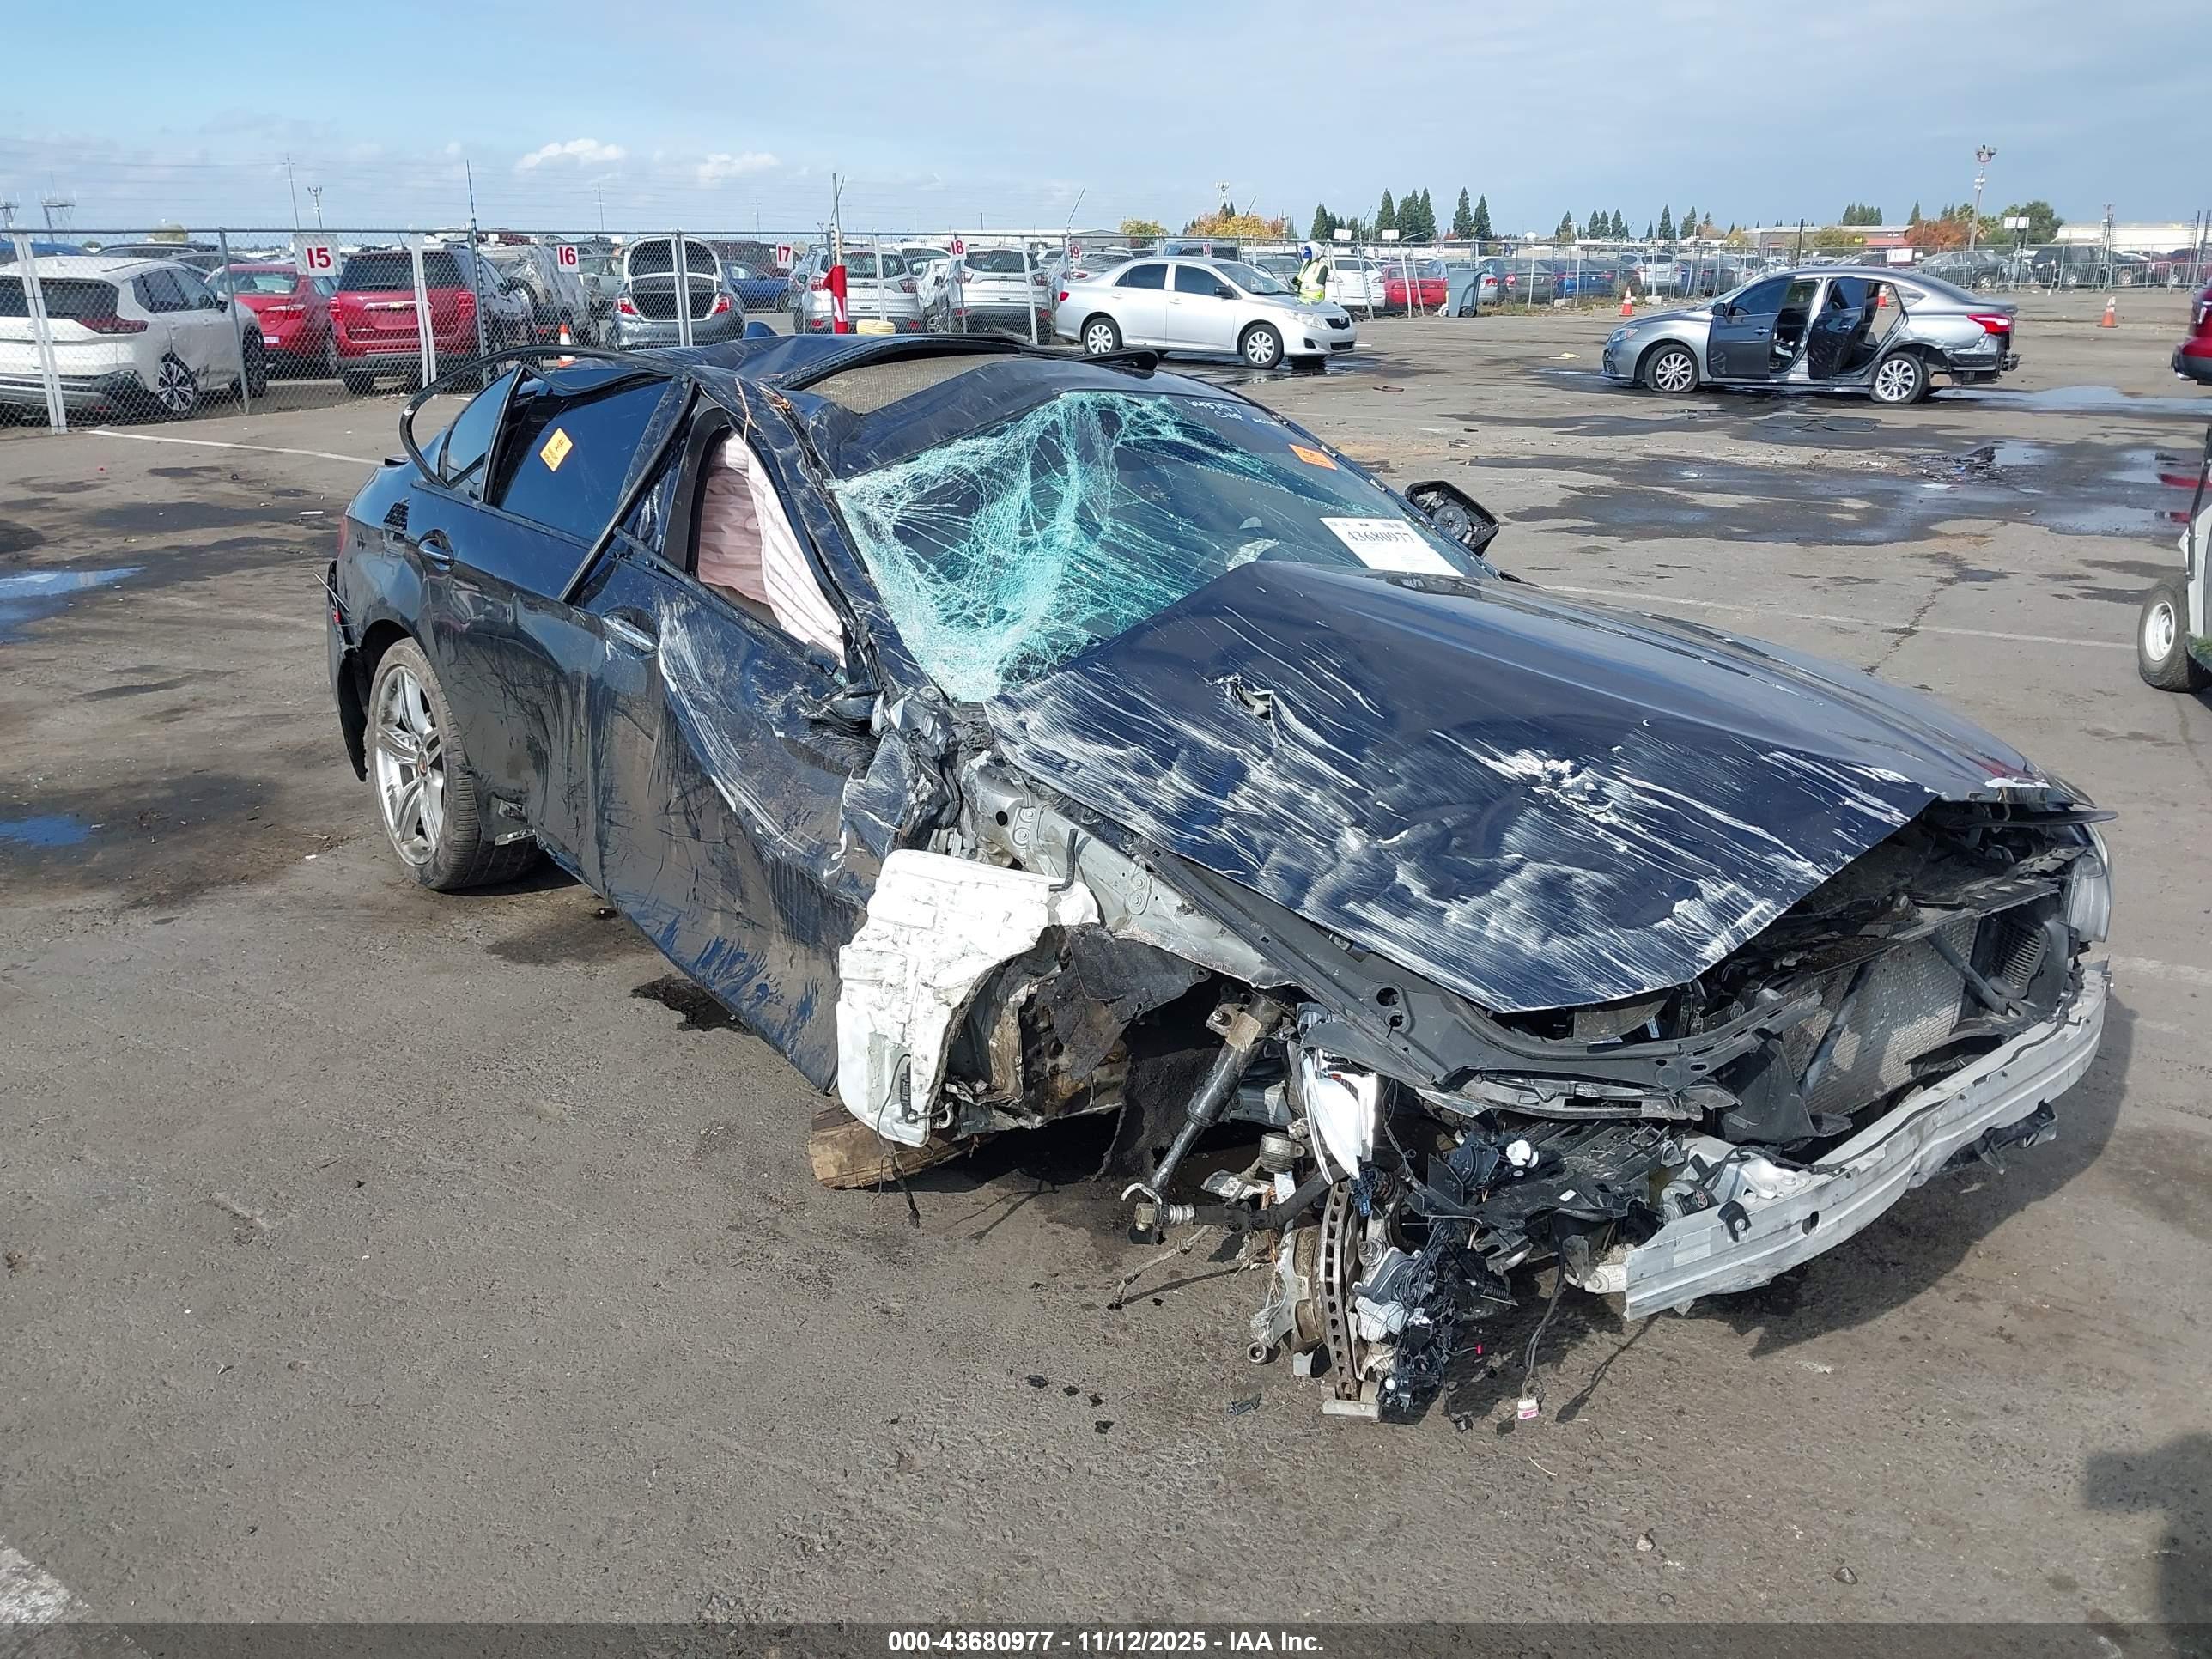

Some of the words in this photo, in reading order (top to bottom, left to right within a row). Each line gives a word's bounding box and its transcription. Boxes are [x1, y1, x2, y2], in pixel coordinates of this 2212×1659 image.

[558, 246, 576, 265] 16
[777, 246, 791, 262] 17
[951, 240, 964, 255] 18
[307, 247, 331, 268] 15
[1346, 531, 1415, 544] 43680977
